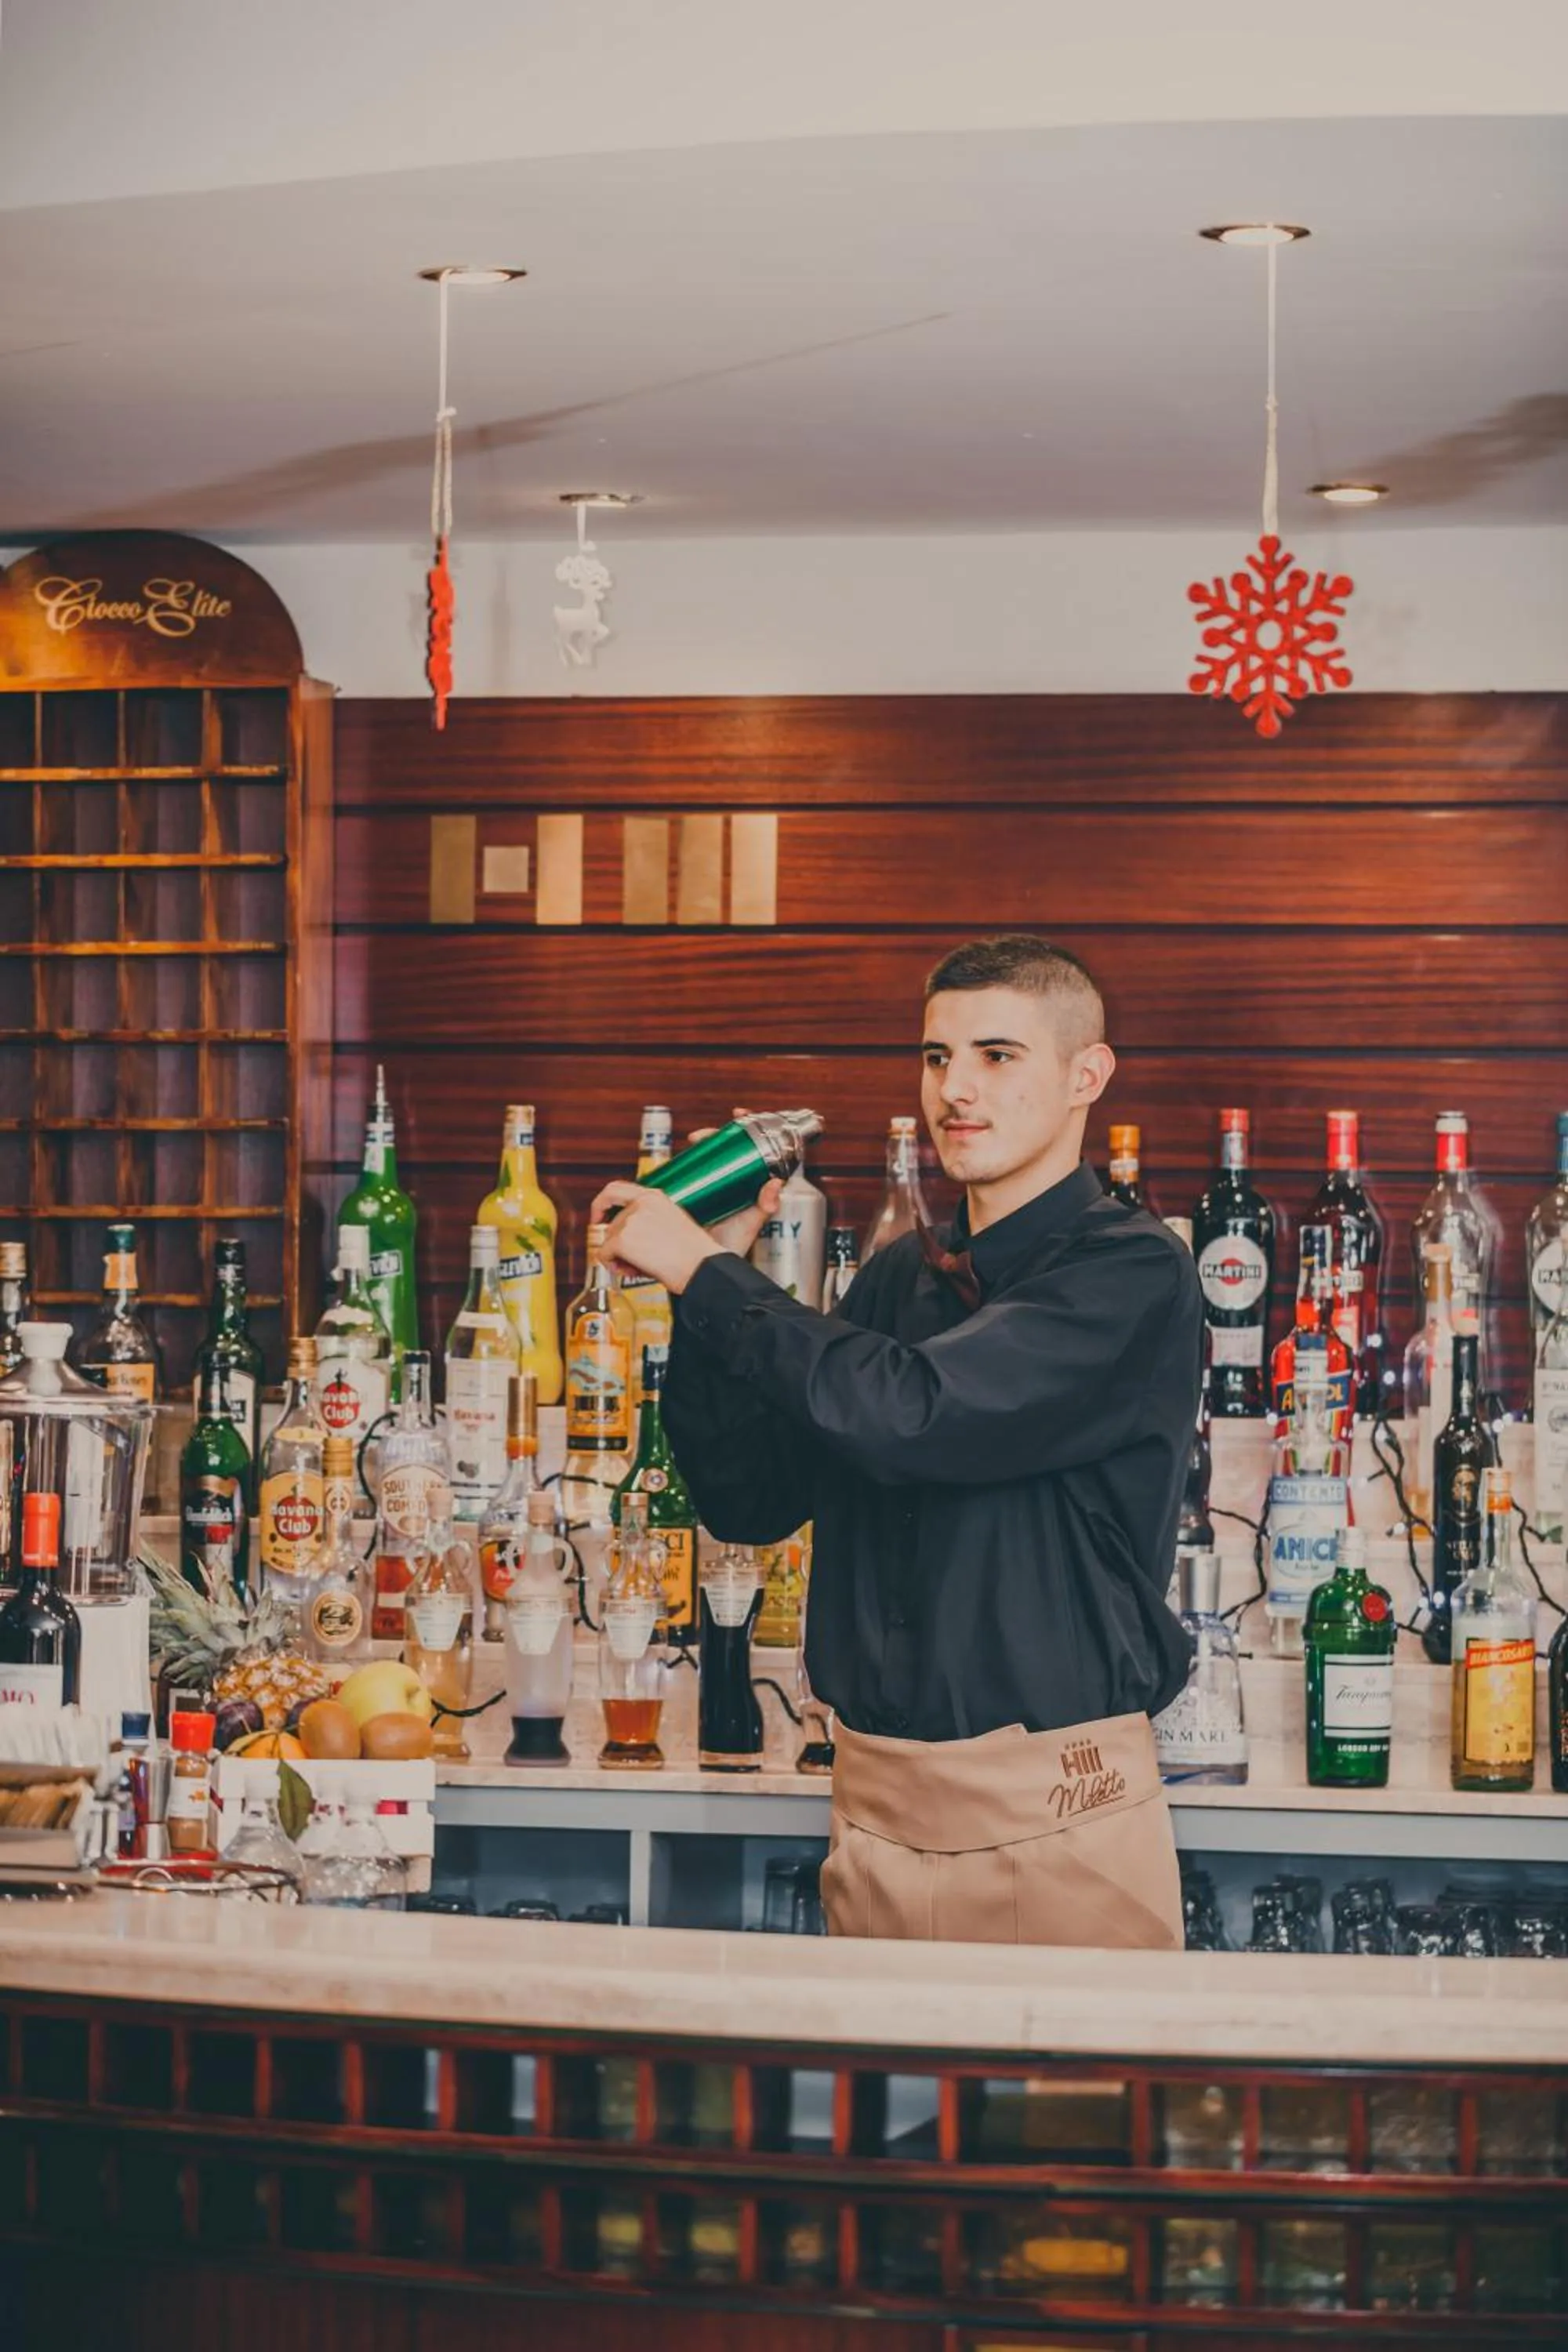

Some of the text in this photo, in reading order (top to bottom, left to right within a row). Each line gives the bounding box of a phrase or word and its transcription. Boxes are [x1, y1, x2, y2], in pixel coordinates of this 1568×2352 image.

[1202, 1265, 1261, 1279] MARTINI
[323, 1403, 355, 1420] Club
[278, 1518, 311, 1534] Club
